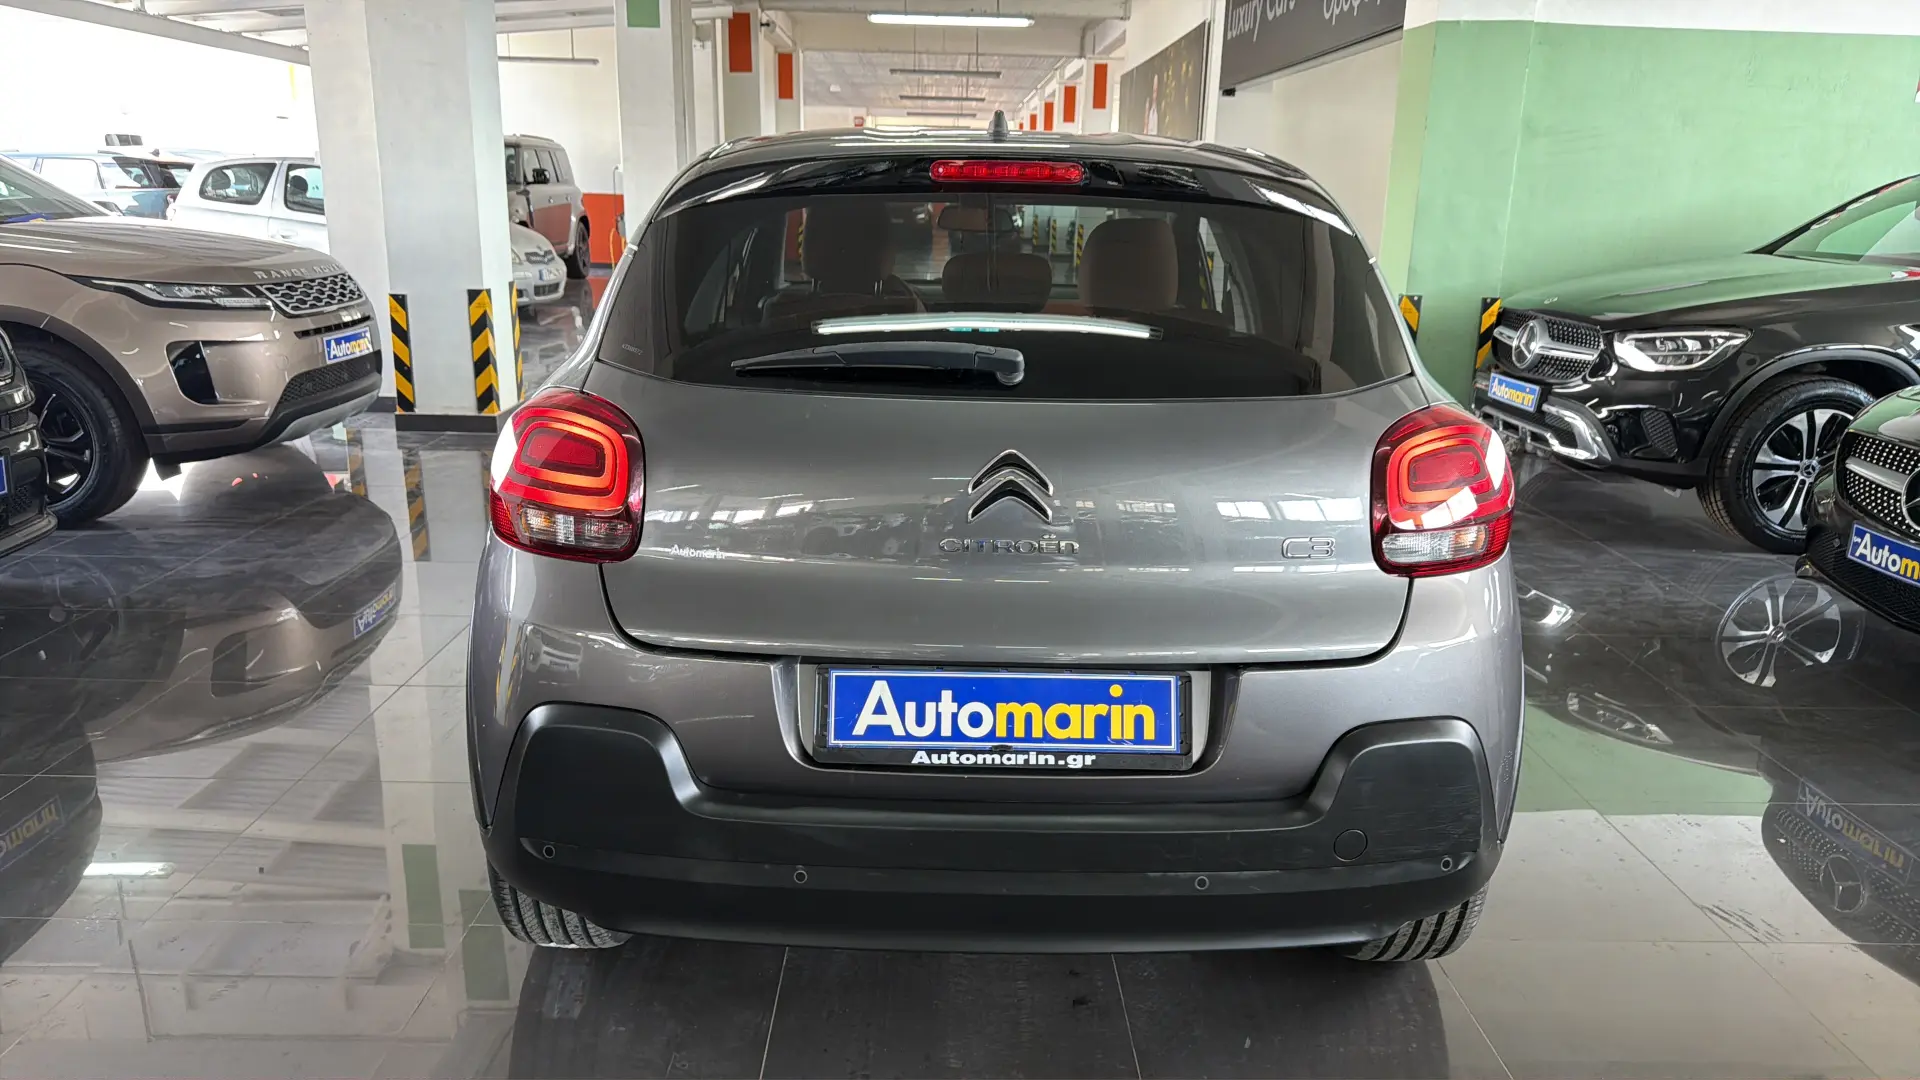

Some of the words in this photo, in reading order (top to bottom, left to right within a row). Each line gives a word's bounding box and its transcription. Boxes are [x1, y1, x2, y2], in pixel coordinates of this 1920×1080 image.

[1226, 0, 1263, 42] Luxury
[253, 268, 309, 280] RANGE
[1491, 377, 1535, 407] Automarin
[669, 544, 726, 559] Automarin
[1281, 537, 1336, 559] C3
[1855, 532, 1920, 580] Autom
[852, 679, 1156, 740] Automarin
[911, 750, 1097, 769] Automarin.gr
